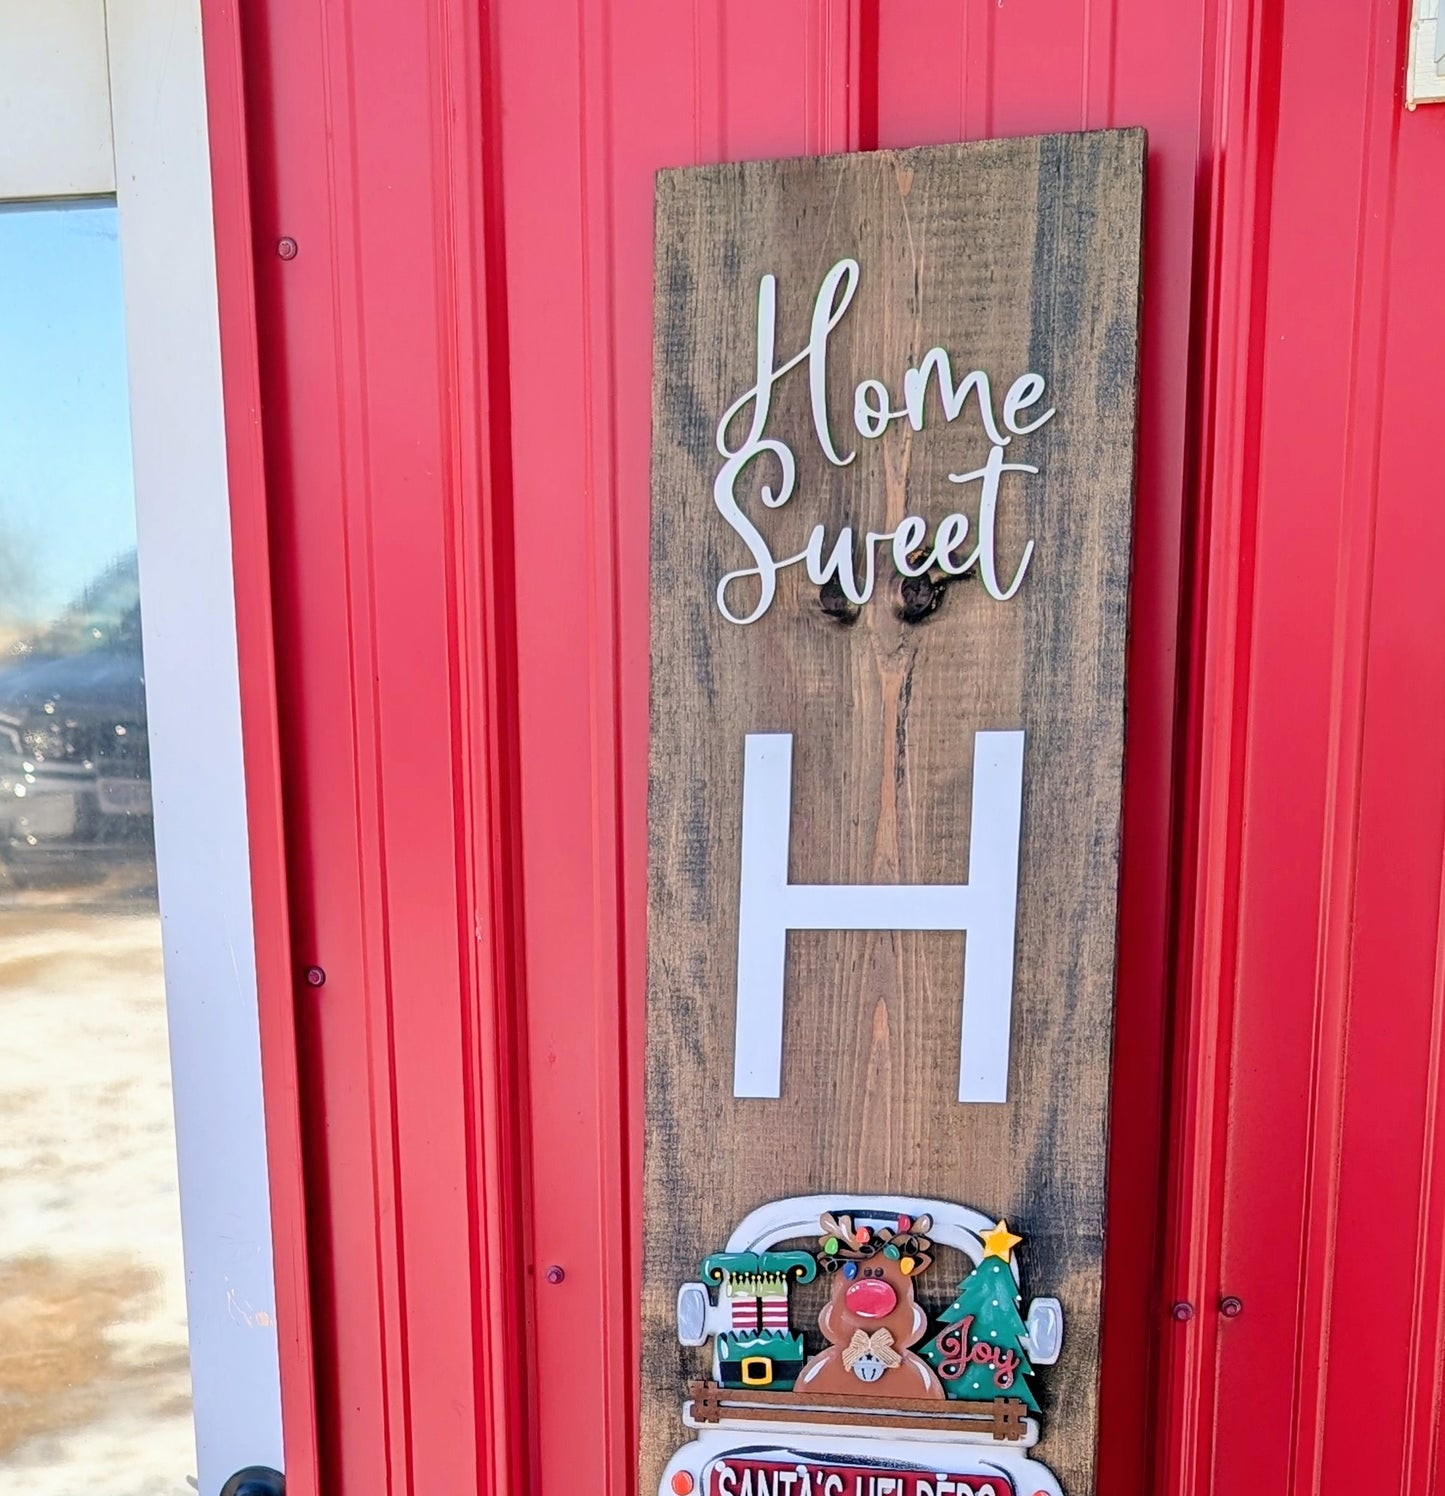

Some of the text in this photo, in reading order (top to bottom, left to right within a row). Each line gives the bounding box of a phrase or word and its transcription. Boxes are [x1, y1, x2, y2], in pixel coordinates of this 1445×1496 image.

[716, 258, 1056, 466] Home
[714, 438, 1039, 625] Sweet
[936, 1315, 1020, 1390] Joy
